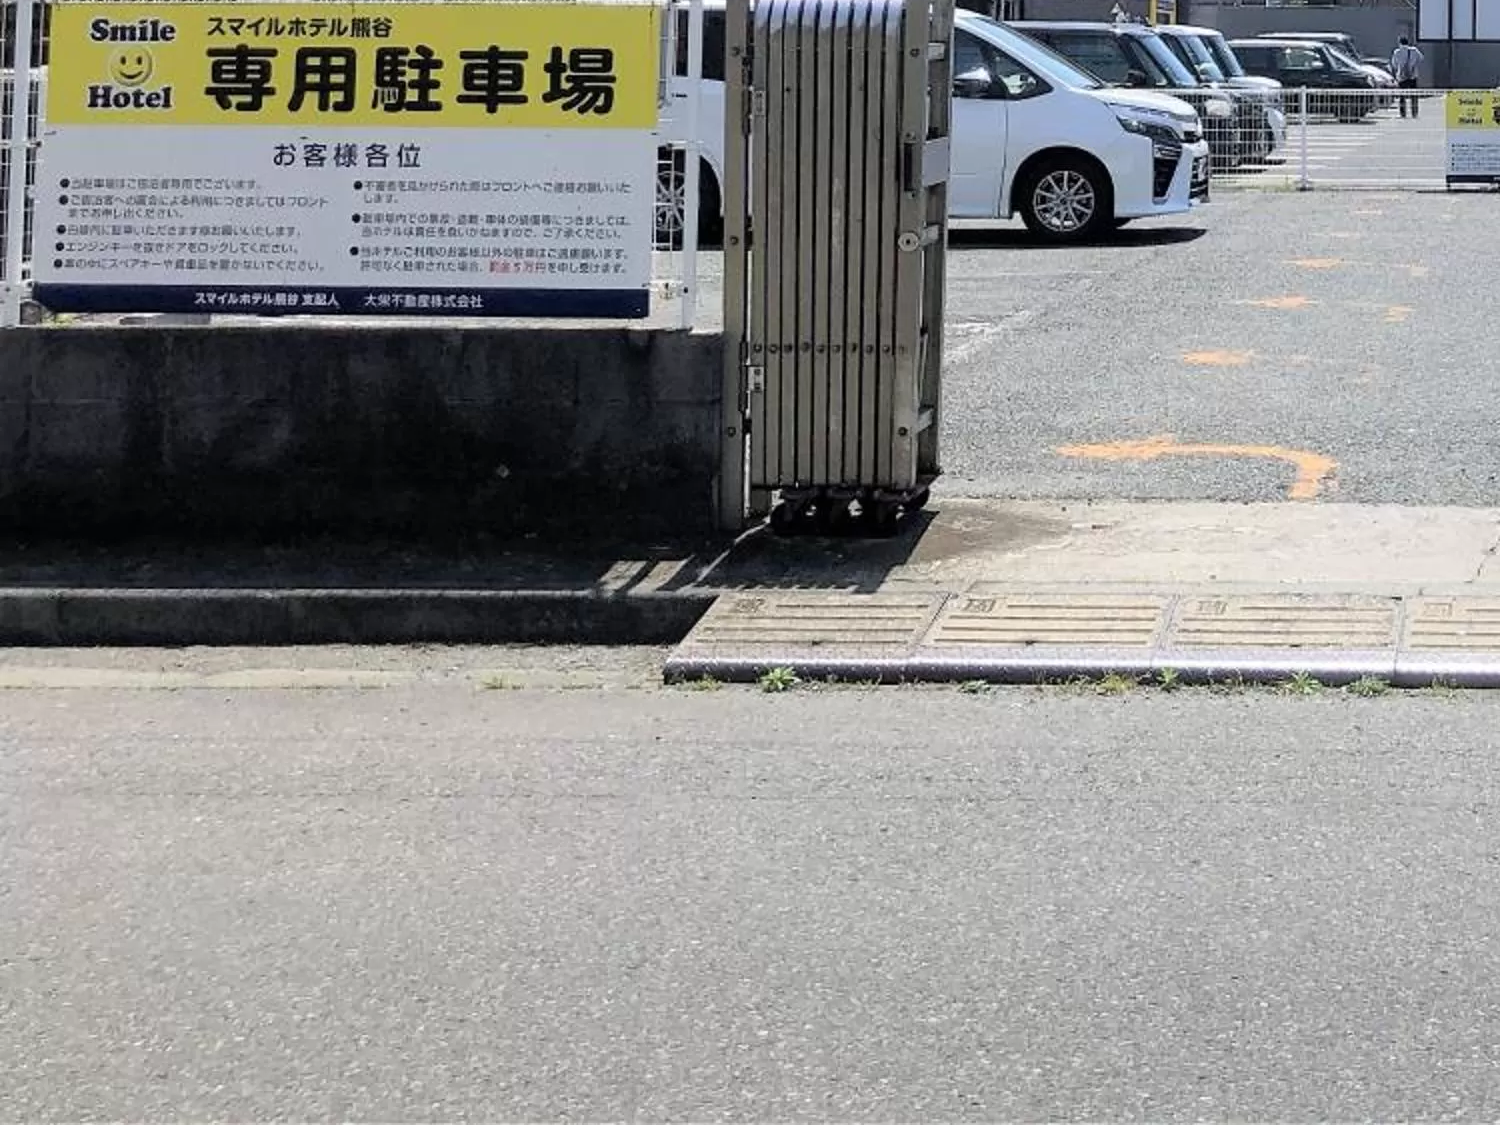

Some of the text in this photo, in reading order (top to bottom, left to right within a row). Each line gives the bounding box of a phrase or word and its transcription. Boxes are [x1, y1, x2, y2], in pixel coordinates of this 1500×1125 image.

[91, 18, 176, 41] Smile
[207, 16, 392, 39] スマイルホテル熊谷
[204, 43, 618, 116] 専用駐車場
[87, 86, 172, 109] Hotel
[273, 143, 422, 169] お客様各位
[194, 292, 485, 308] スマイルホテル熊谷 支配人 大栄不動産株式会社
